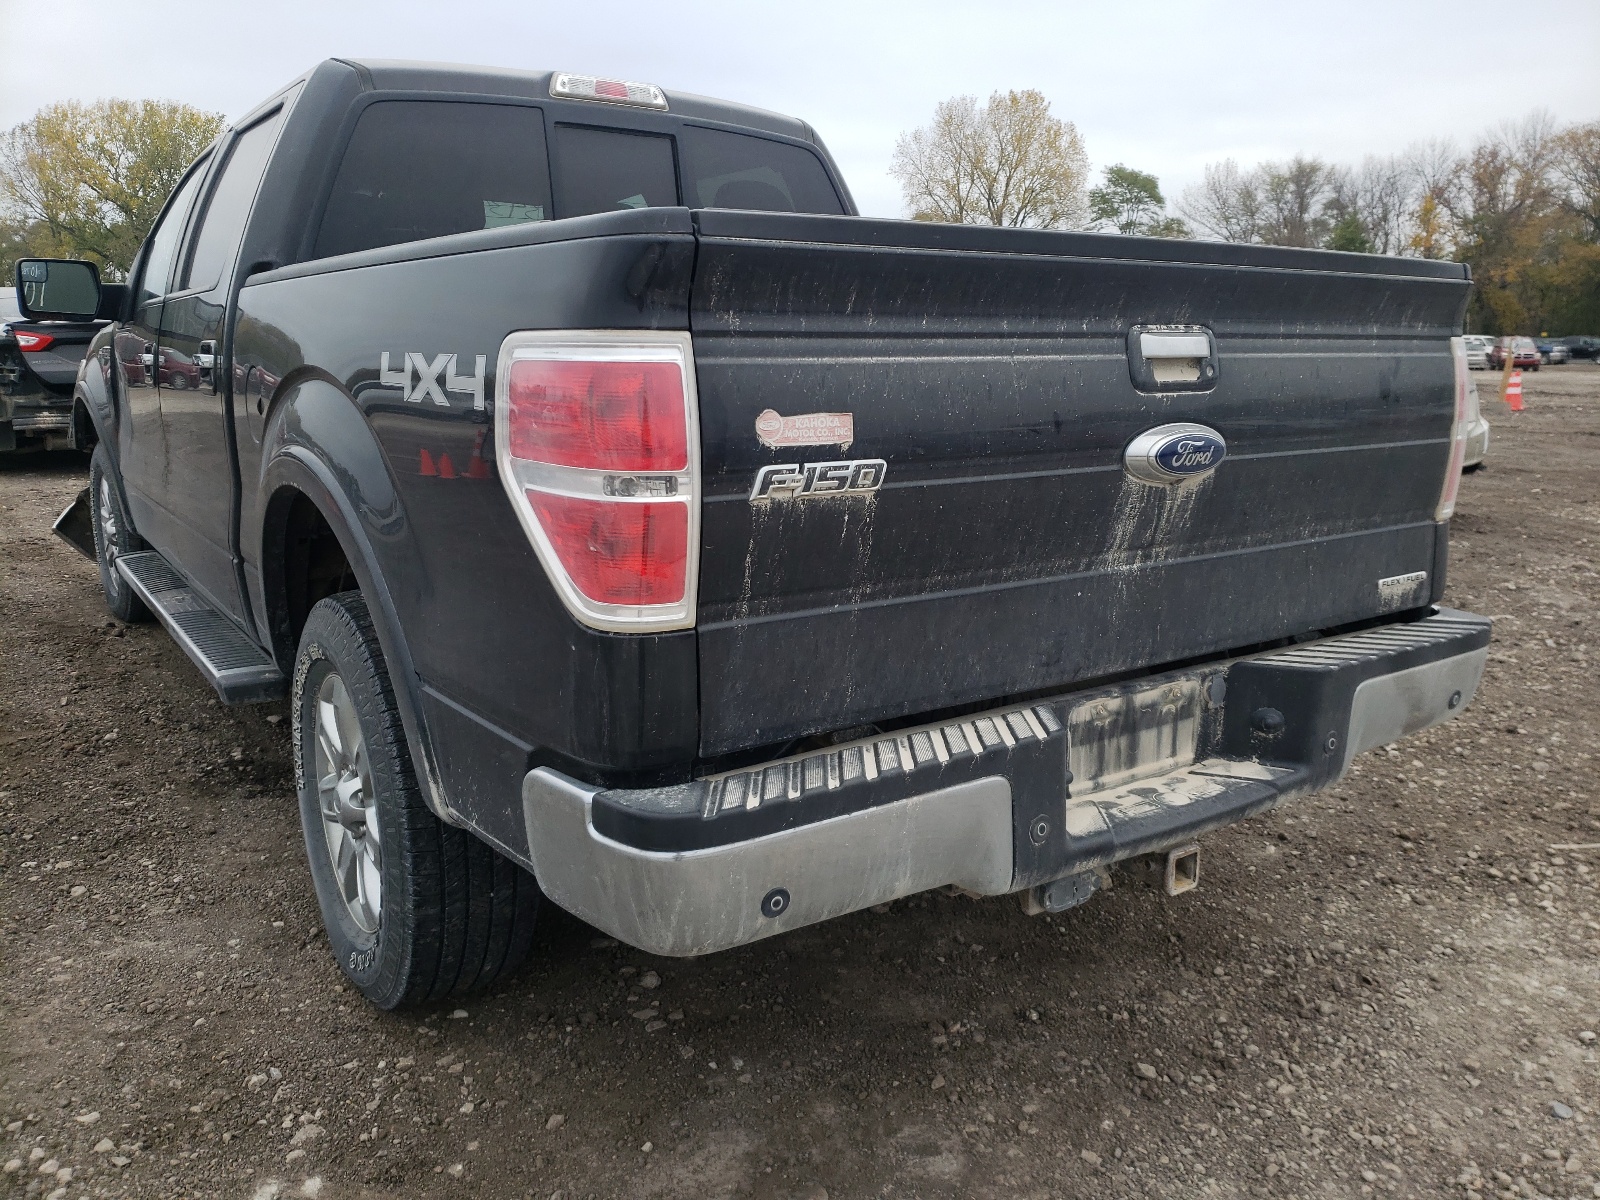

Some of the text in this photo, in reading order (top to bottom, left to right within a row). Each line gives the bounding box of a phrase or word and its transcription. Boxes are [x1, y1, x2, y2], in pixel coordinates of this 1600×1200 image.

[796, 417, 841, 428] KAHOKA
[785, 428, 815, 438] MOTOR
[1172, 440, 1215, 467] Ford
[1382, 578, 1401, 587] FLEX
